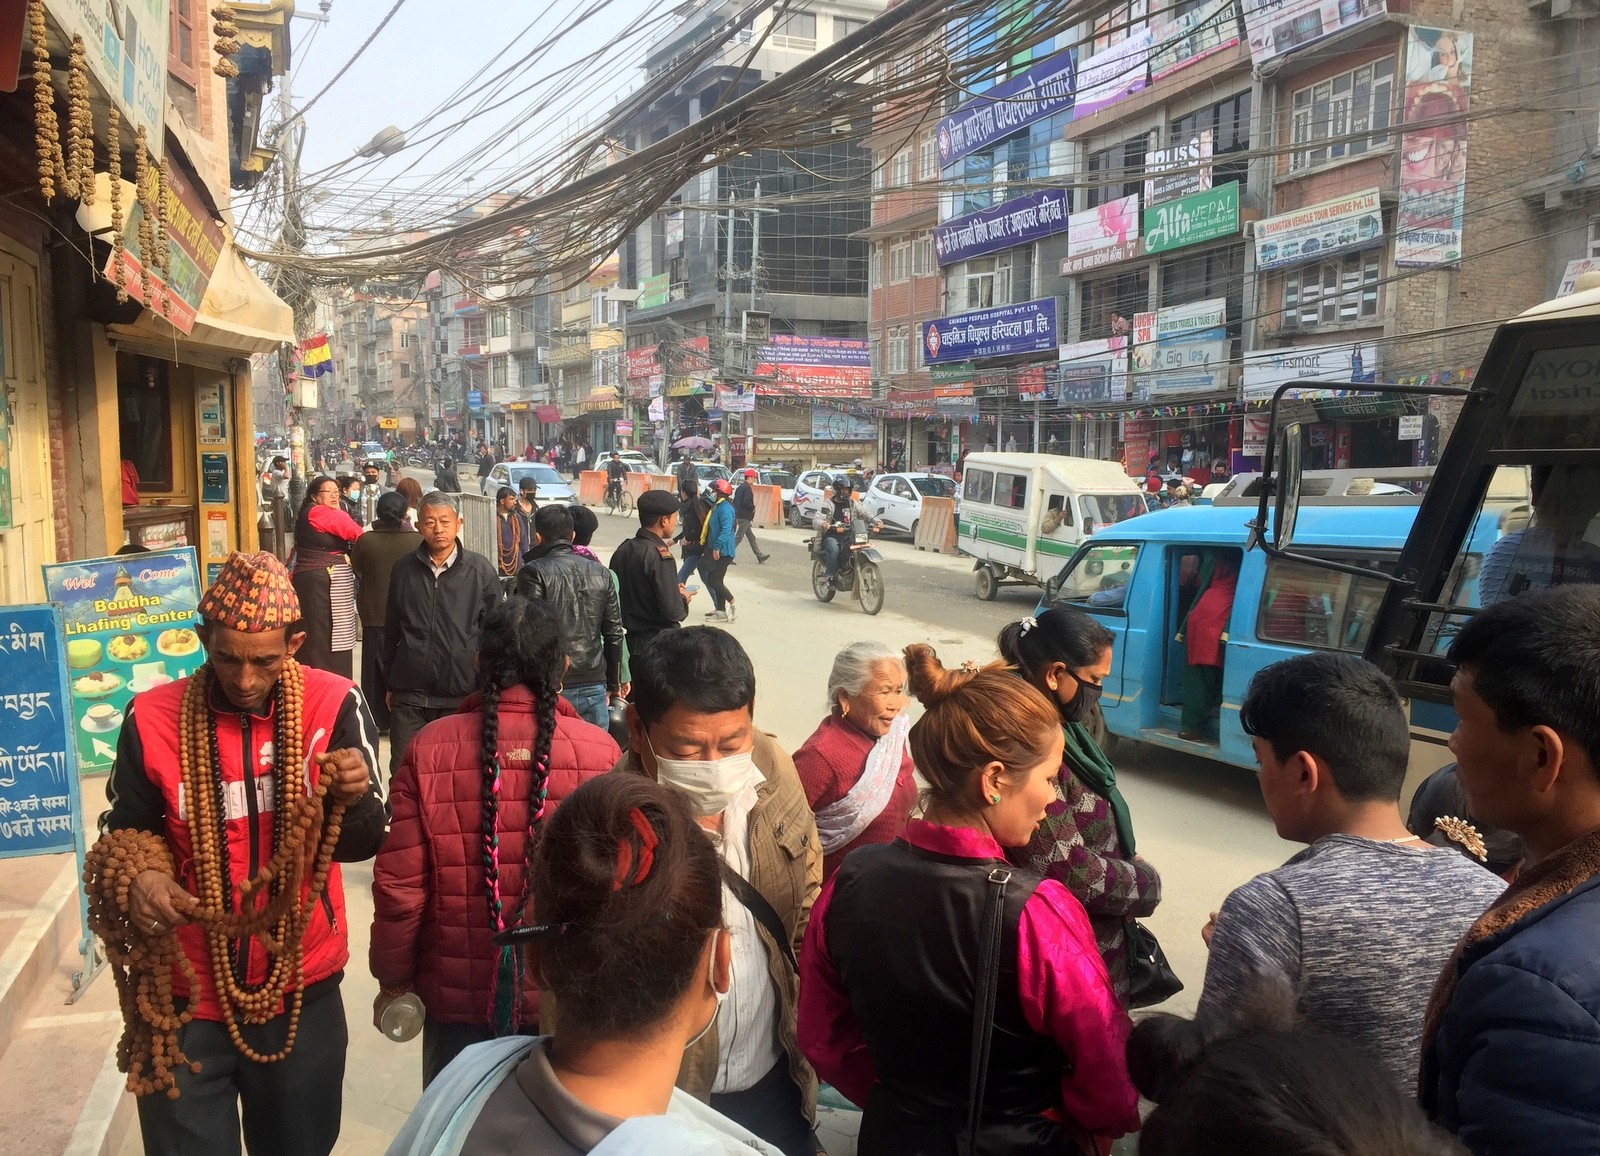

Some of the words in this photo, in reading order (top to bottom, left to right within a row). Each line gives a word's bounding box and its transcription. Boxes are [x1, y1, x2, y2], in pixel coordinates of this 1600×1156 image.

[138, 31, 161, 93] HOYA
[137, 79, 160, 129] Crizal
[1145, 203, 1191, 252] Alfa
[1191, 196, 1235, 222] NEPAL
[1291, 215, 1314, 227] VEHICLE
[1314, 211, 1329, 221] TOUR
[1329, 201, 1353, 217] SERVICE
[948, 317, 968, 325] CHINESE
[968, 314, 989, 323] PEOPLES
[989, 310, 1013, 319] HOSPITAL
[1014, 307, 1027, 316] PVT.
[1027, 304, 1039, 312] LTD.
[1134, 313, 1156, 328] LUCKY
[1137, 330, 1151, 343] SPA
[796, 374, 849, 386] HOSPITAL
[1343, 404, 1378, 415] CENTER
[63, 573, 99, 591] Wel
[139, 568, 180, 583] Come
[94, 594, 161, 613] Boudha
[66, 617, 132, 635] Lhafing
[136, 608, 194, 625] Center
